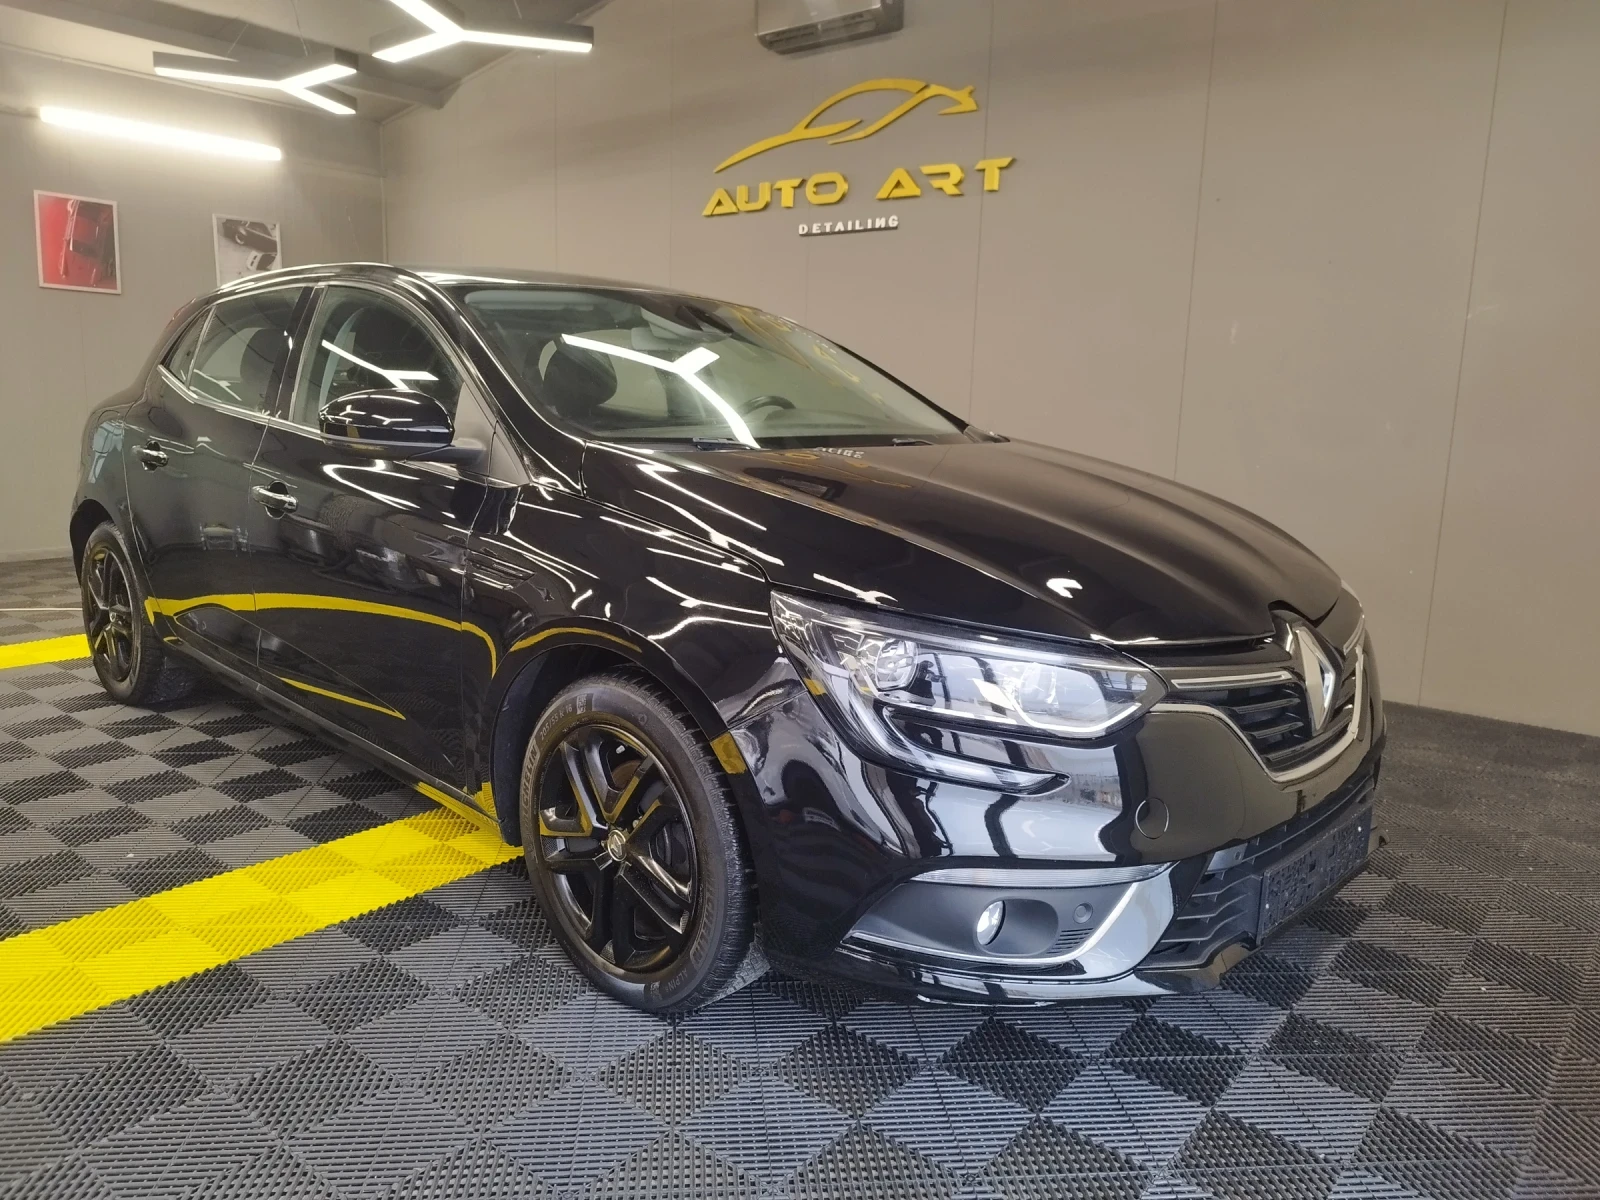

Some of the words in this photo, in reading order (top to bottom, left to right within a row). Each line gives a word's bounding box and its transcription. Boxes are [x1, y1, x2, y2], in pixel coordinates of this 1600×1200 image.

[702, 171, 849, 216] AUTO
[875, 157, 1016, 200] ART
[798, 215, 899, 235] DETAILING
